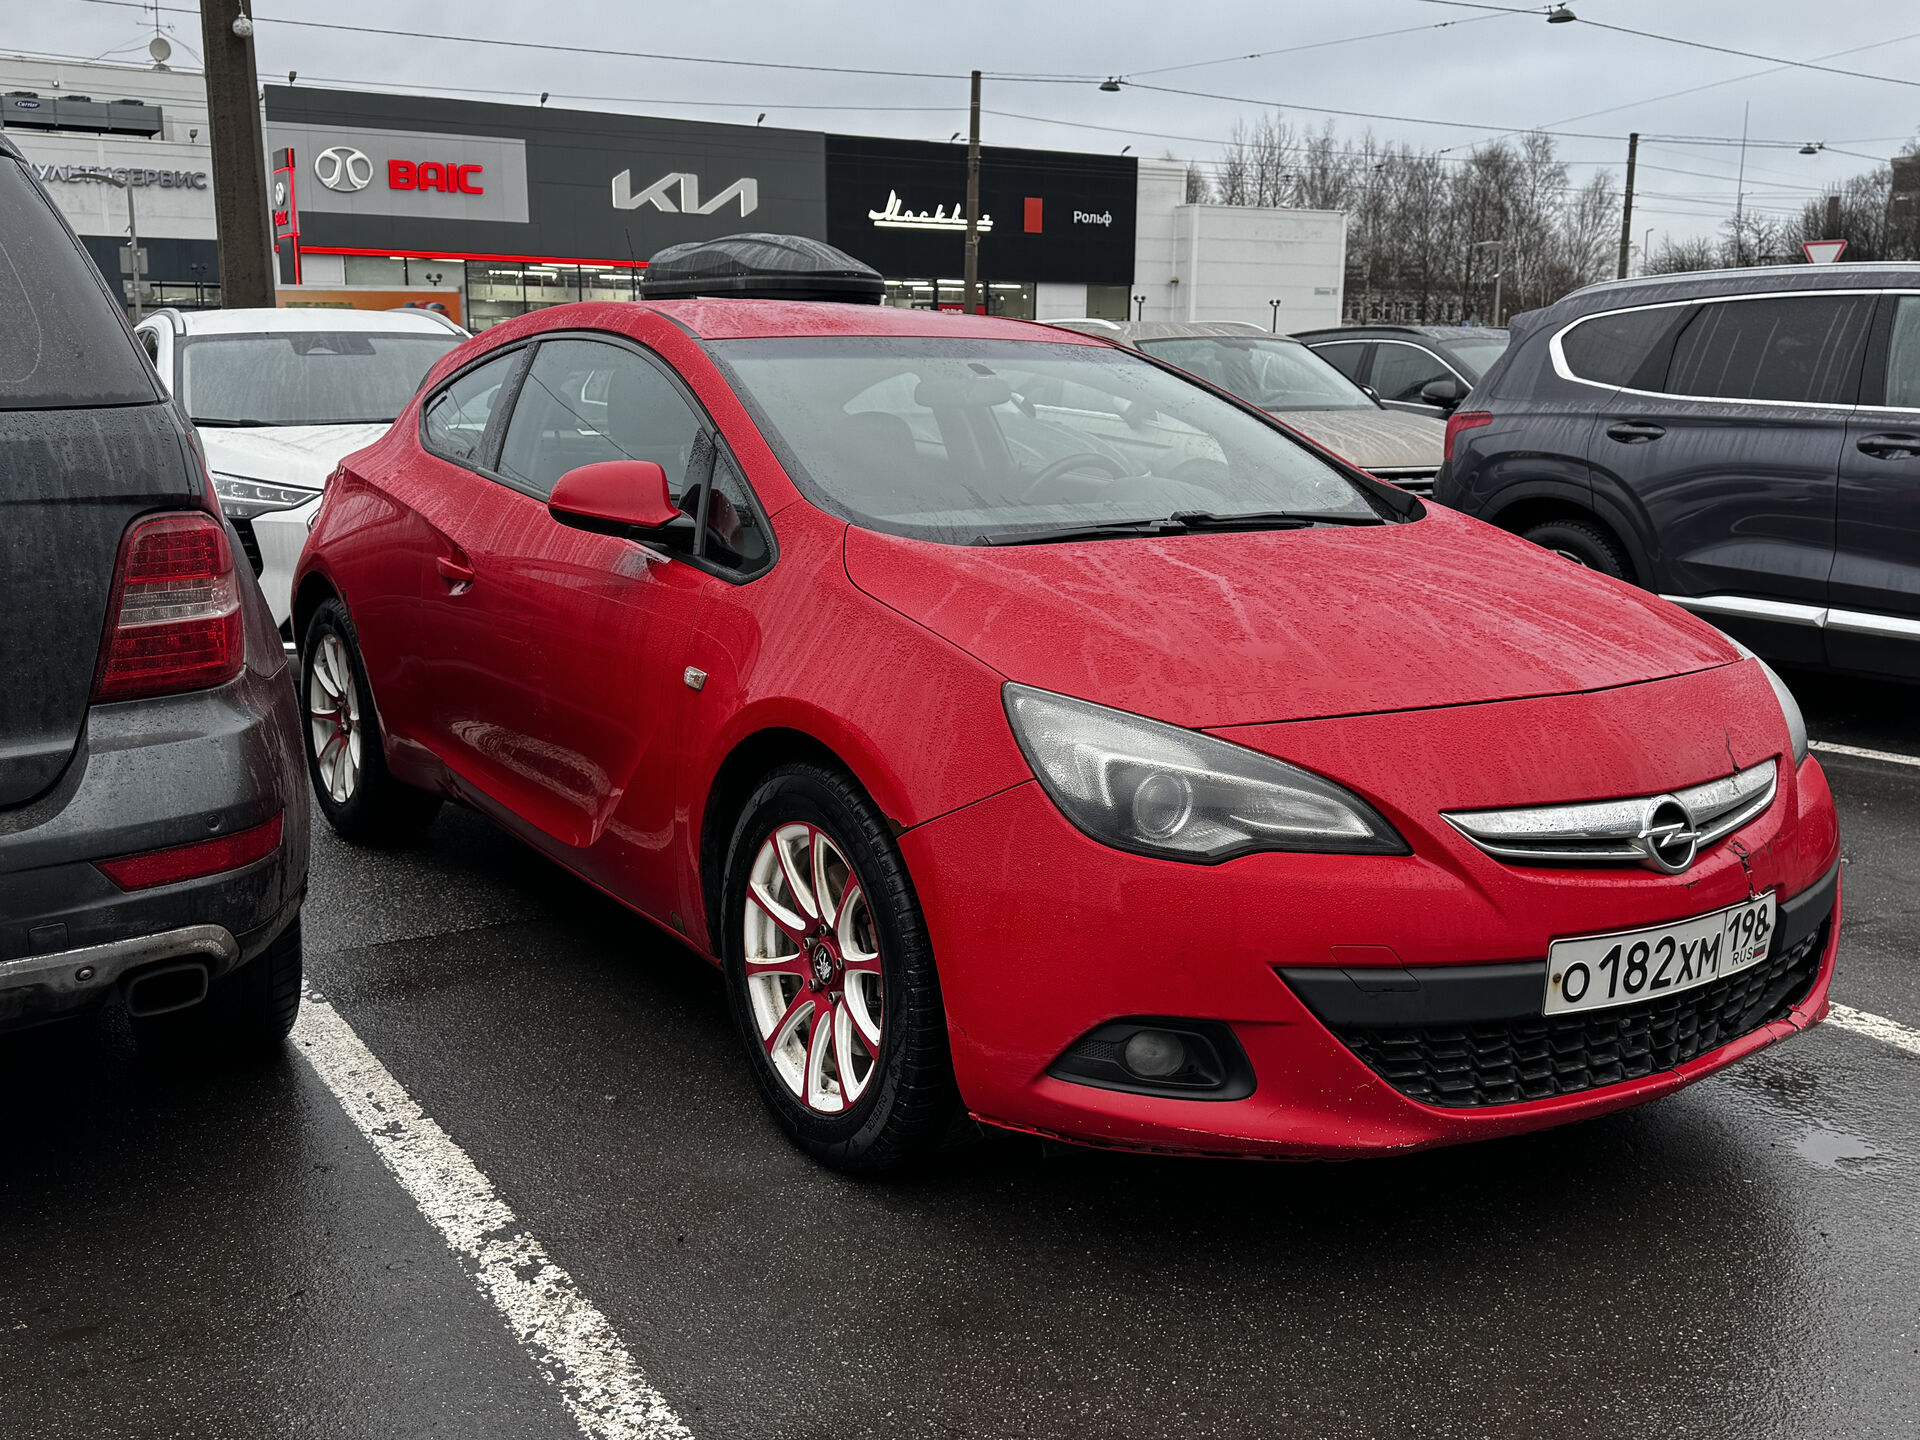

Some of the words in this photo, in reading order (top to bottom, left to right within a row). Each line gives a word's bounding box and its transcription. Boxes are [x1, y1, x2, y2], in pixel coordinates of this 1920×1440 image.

[30, 163, 207, 190] УЛЬТИСЕРВИС
[388, 159, 484, 194] BAIC
[611, 168, 758, 218] KIA
[1073, 210, 1112, 227] Рольф
[1728, 903, 1767, 951] 198
[1731, 946, 1753, 966] RUS
